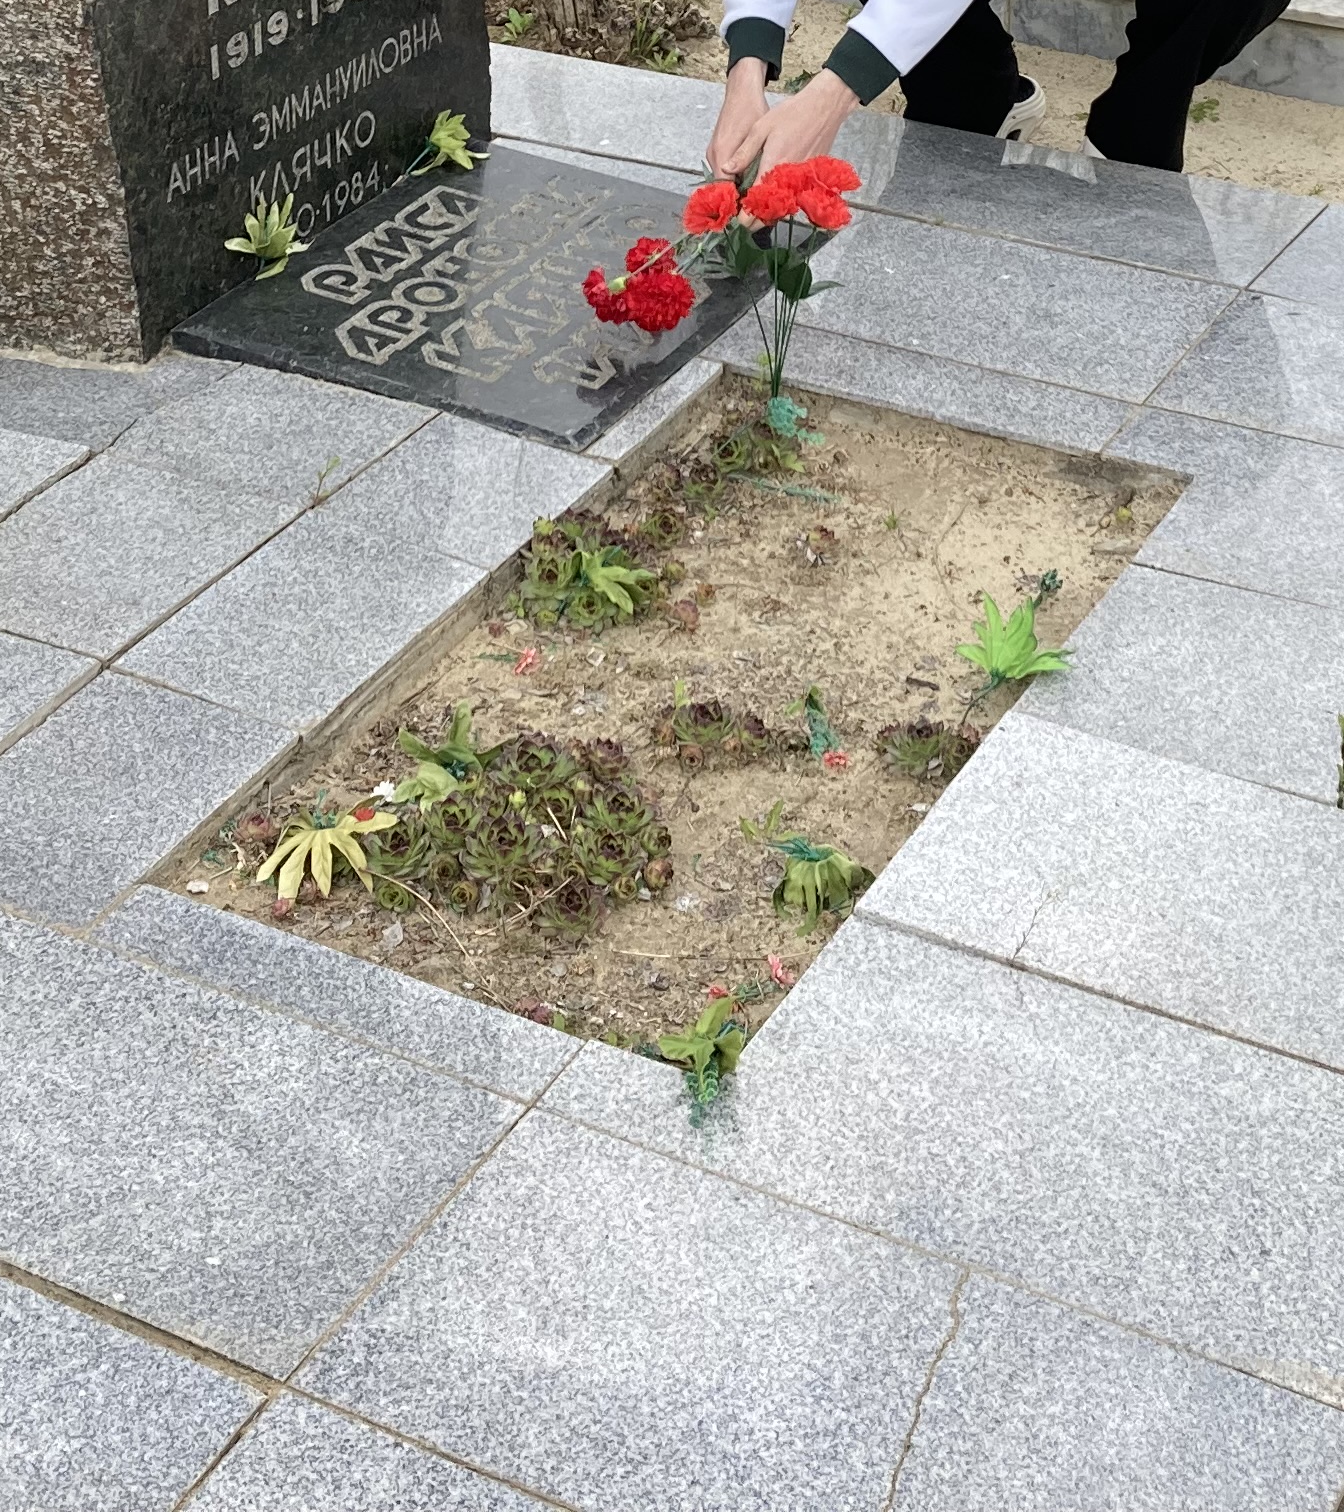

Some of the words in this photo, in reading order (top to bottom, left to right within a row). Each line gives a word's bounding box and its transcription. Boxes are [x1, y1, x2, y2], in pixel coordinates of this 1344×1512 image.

[167, 131, 240, 203] АННА
[252, 13, 443, 151] ЭММАНУИЛОВНА
[250, 110, 376, 215] КЛЯЧКО
[301, 185, 485, 305] РАИСА
